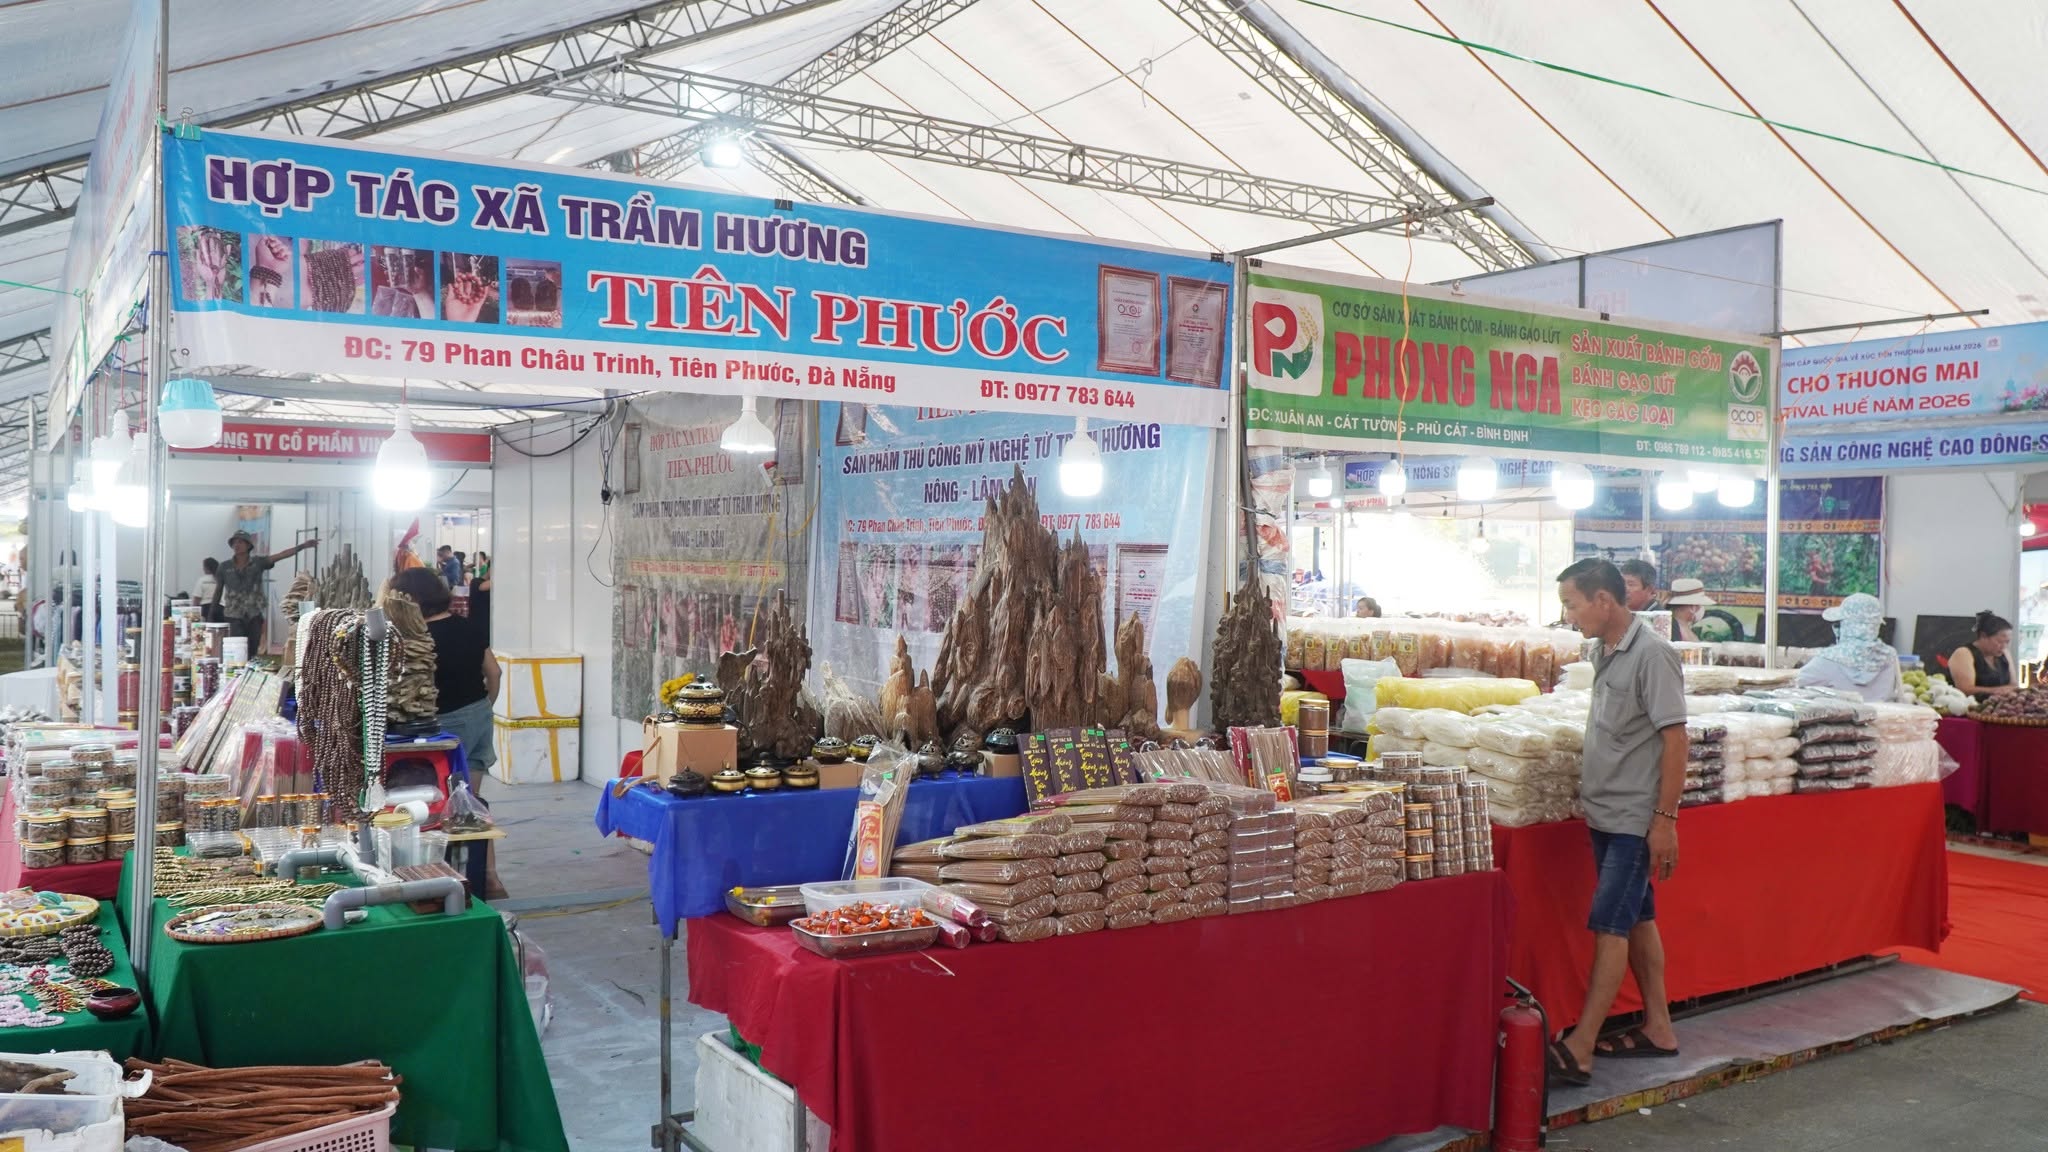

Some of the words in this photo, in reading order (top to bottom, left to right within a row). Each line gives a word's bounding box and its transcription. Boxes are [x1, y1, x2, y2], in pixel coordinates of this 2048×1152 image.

[209, 158, 330, 214] HỢP
[351, 171, 456, 222] TÁC
[475, 184, 546, 234] XÃ
[562, 194, 700, 247] TRẦM
[717, 215, 866, 265] HƯƠNG
[591, 266, 794, 339] TIÊN
[812, 294, 1067, 361] PHƯỚC
[1490, 320, 1517, 339] BÁNH
[344, 336, 392, 360] ĐC:
[401, 340, 435, 363] 79
[445, 342, 511, 367] Phan
[521, 347, 584, 371] Châu
[593, 351, 661, 378] Trinh,
[669, 356, 716, 379] Tiên
[725, 360, 801, 386] Phước,
[808, 366, 835, 387] Đà
[843, 366, 896, 393] Nẵng
[1571, 329, 1602, 355] SẢN
[1606, 334, 1643, 360] XUẤT
[1646, 340, 1686, 366] BÁNH
[1332, 331, 1476, 407] PHONG
[1489, 349, 1562, 415] NGA
[1572, 362, 1614, 388] BÁNH
[1617, 370, 1651, 396] GẠO
[980, 379, 1008, 399] ĐT:
[1015, 382, 1061, 402] 0977
[1067, 386, 1099, 405] 783
[1104, 388, 1135, 408] 644
[1833, 394, 1868, 416] HUẾ
[1873, 397, 1914, 413] NĂM
[1919, 393, 1970, 410] 2026
[1248, 407, 1273, 422] ĐC:
[1274, 407, 1305, 425] XUÂN
[1306, 414, 1323, 427] AN
[1334, 413, 1359, 430] CÁT
[1416, 421, 1441, 435] PHÙ
[1444, 422, 1468, 437] CÁT
[1503, 429, 1529, 443] ĐỊNH
[1642, 404, 1674, 429] LOẠI
[253, 433, 273, 449] TY
[279, 428, 302, 450] CỔ
[307, 430, 353, 453] PHẦN
[928, 442, 961, 467] CÔNG
[965, 437, 985, 465] MỸ
[989, 433, 1030, 465] NGHỆ
[1102, 423, 1161, 453] HƯƠNG
[1800, 441, 1832, 463] SẢN
[1838, 441, 1882, 461] CÔNG
[1888, 436, 1933, 461] NGHỆ
[1940, 438, 1974, 456] CAO
[924, 478, 959, 503] NÔNG
